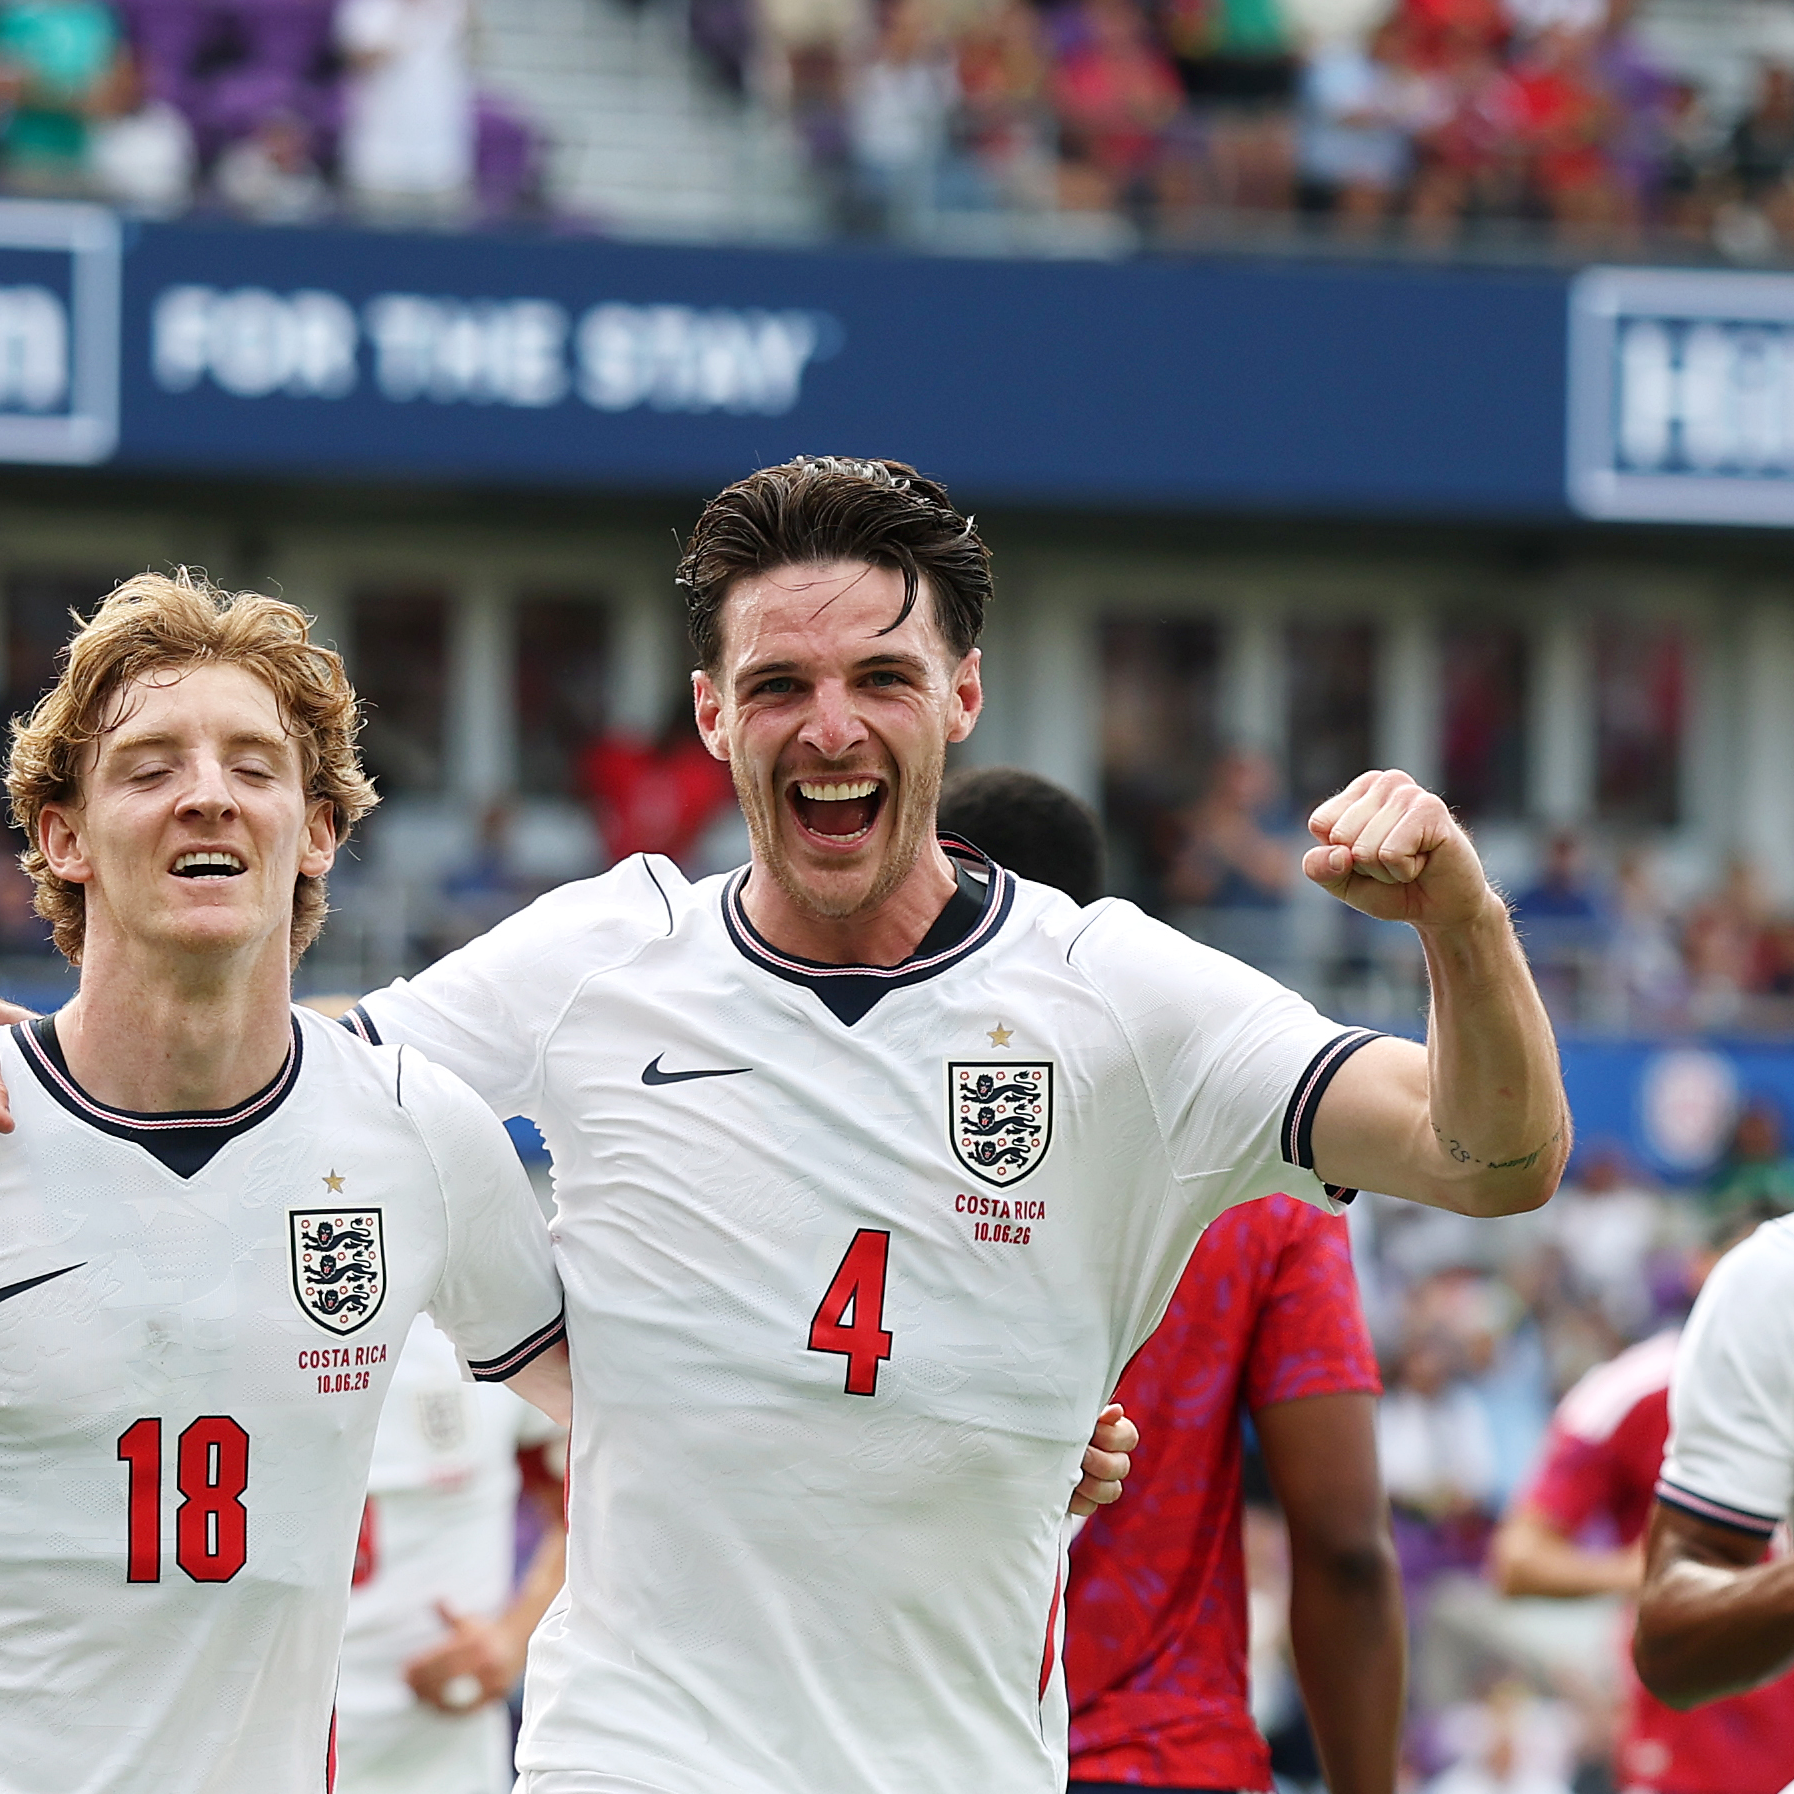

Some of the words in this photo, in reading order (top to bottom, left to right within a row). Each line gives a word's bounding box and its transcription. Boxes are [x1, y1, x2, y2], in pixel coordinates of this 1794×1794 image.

[152, 286, 358, 397] FOR
[368, 294, 570, 407] THE
[579, 303, 818, 415] STAY
[955, 1194, 1010, 1219] COSTA
[1014, 1201, 1045, 1220] RICA
[974, 1222, 1031, 1245] 10.06.26
[807, 1228, 894, 1397] 4
[298, 1348, 350, 1369] COSTA
[355, 1344, 387, 1366] RICA
[317, 1371, 370, 1394] 10.06.26
[117, 1415, 251, 1583] 18
